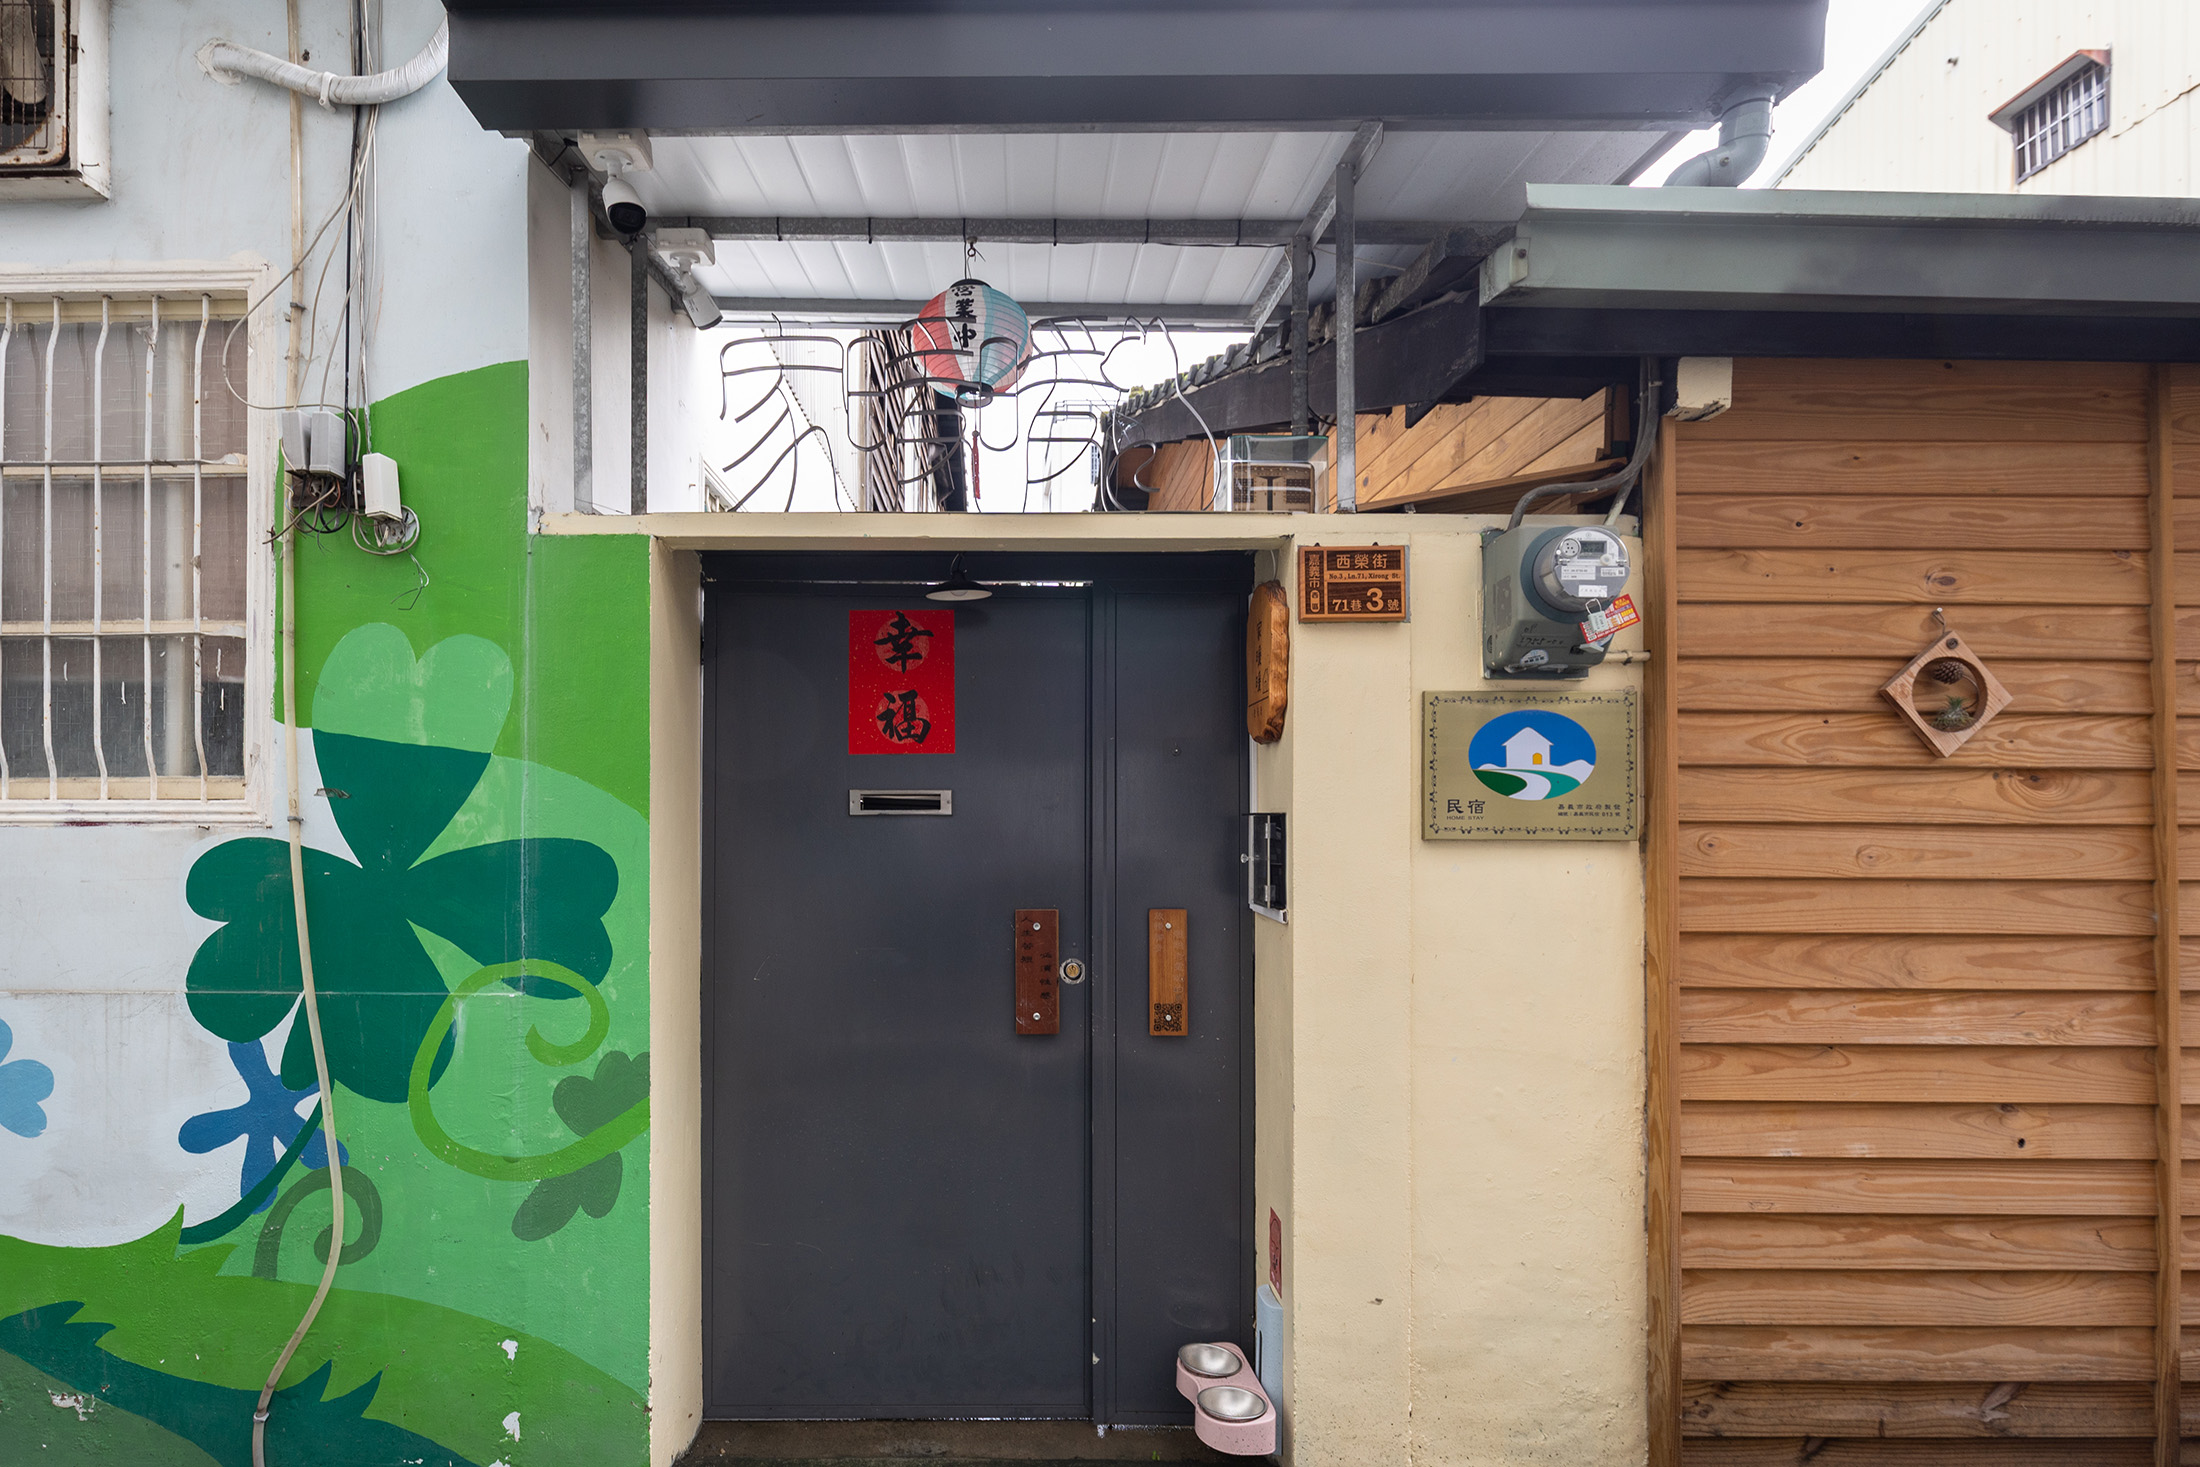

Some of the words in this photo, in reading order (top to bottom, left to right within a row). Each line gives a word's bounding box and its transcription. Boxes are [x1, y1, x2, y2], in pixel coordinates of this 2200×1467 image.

[1336, 553, 1388, 569] 西榮街
[873, 611, 934, 744] 幸福
[1446, 798, 1486, 815] 民宿
